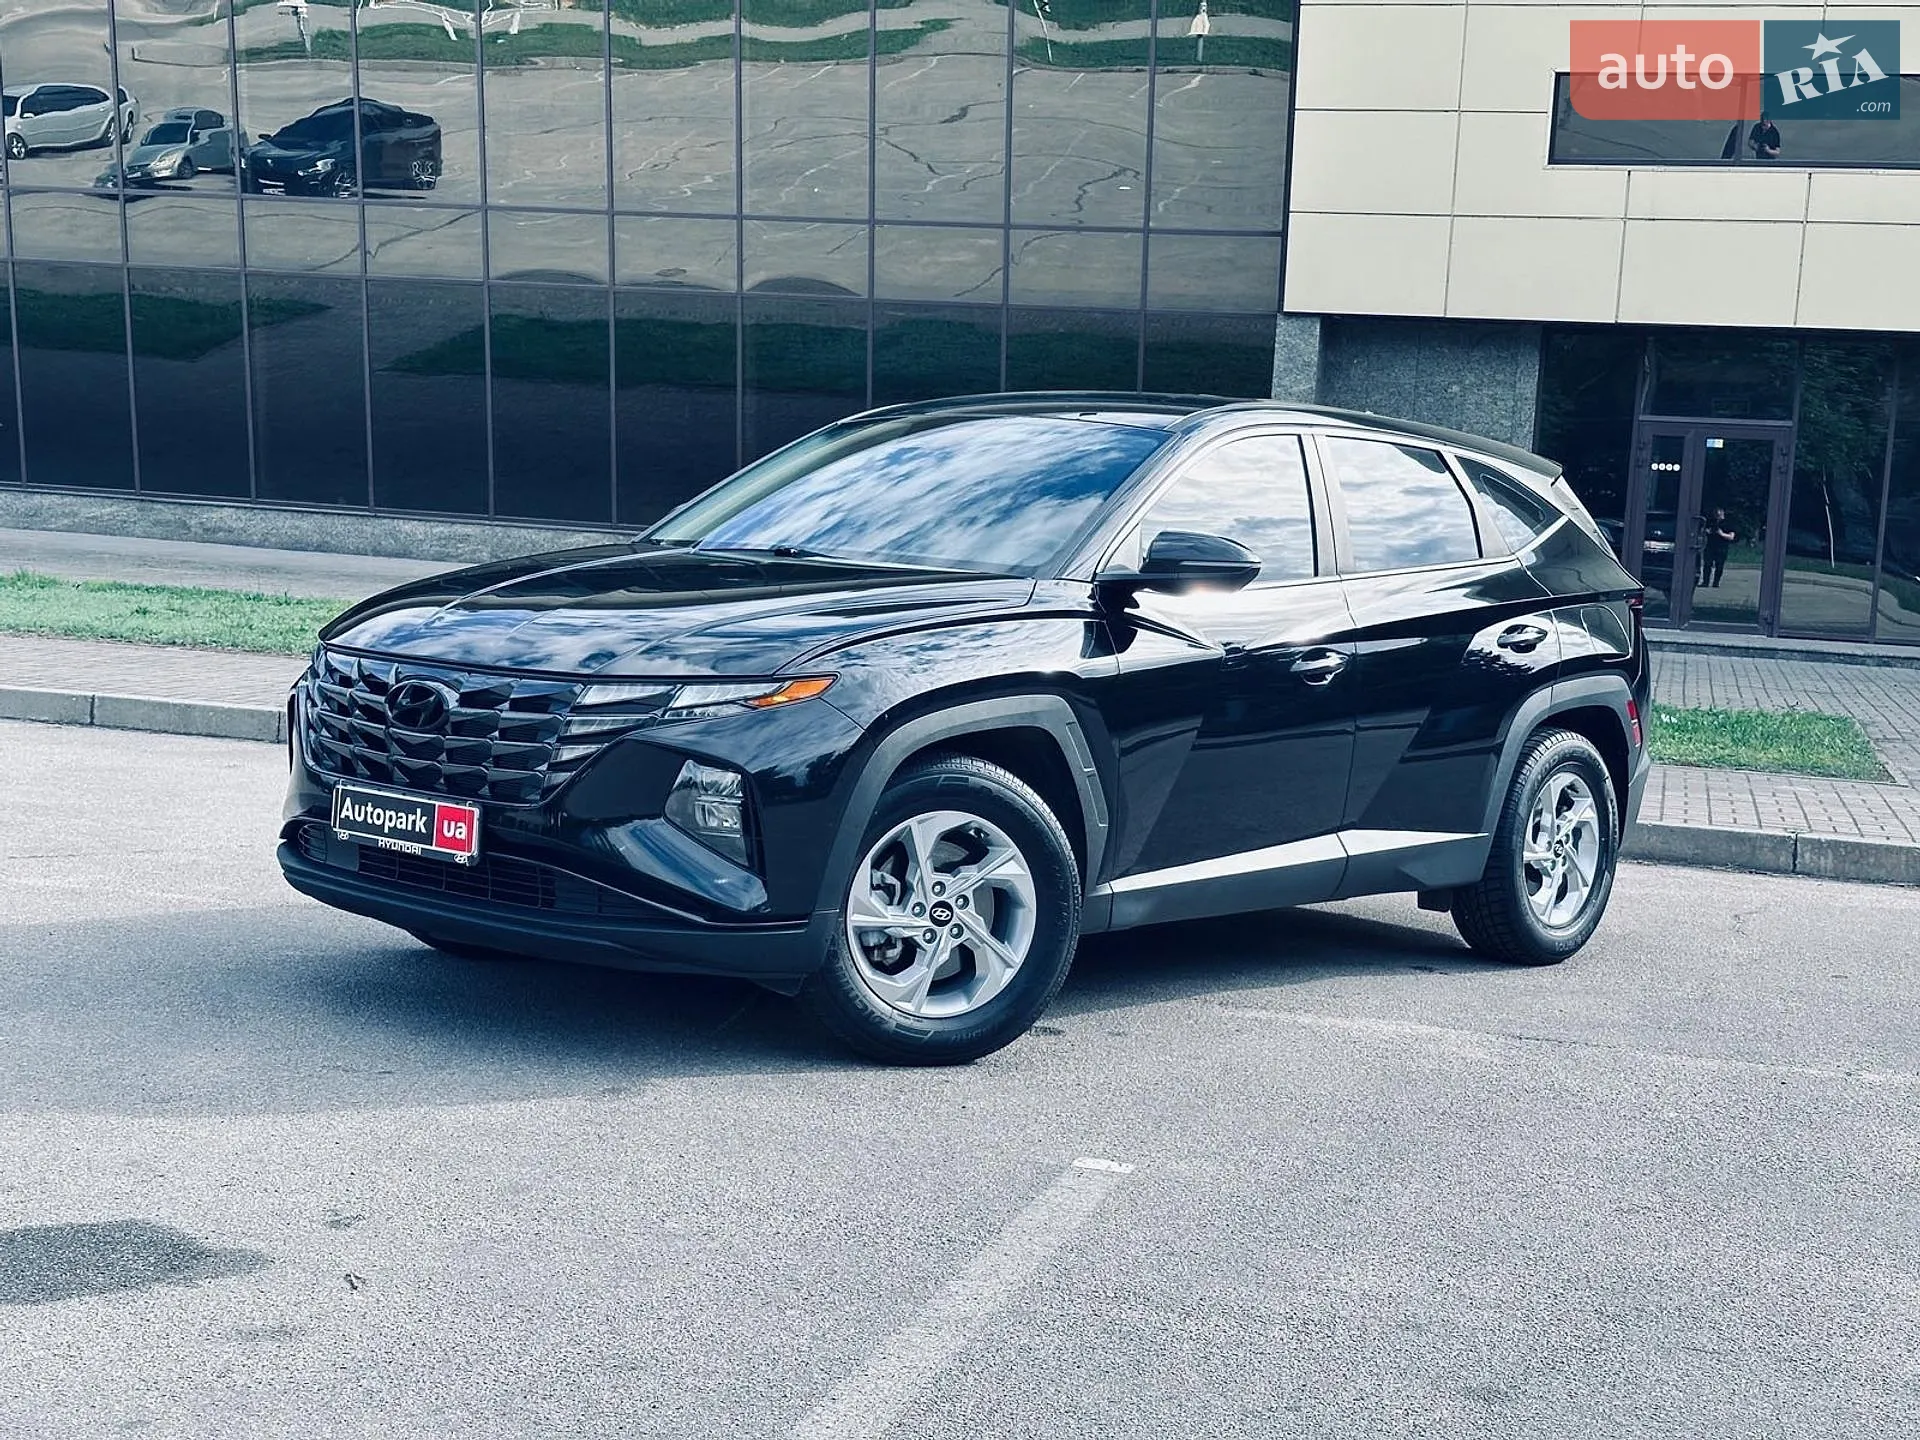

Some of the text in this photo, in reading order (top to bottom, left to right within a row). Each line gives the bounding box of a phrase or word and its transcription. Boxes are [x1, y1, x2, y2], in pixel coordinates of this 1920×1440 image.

[340, 797, 467, 840] Autopark ua
[378, 838, 422, 856] HYUNDAI
